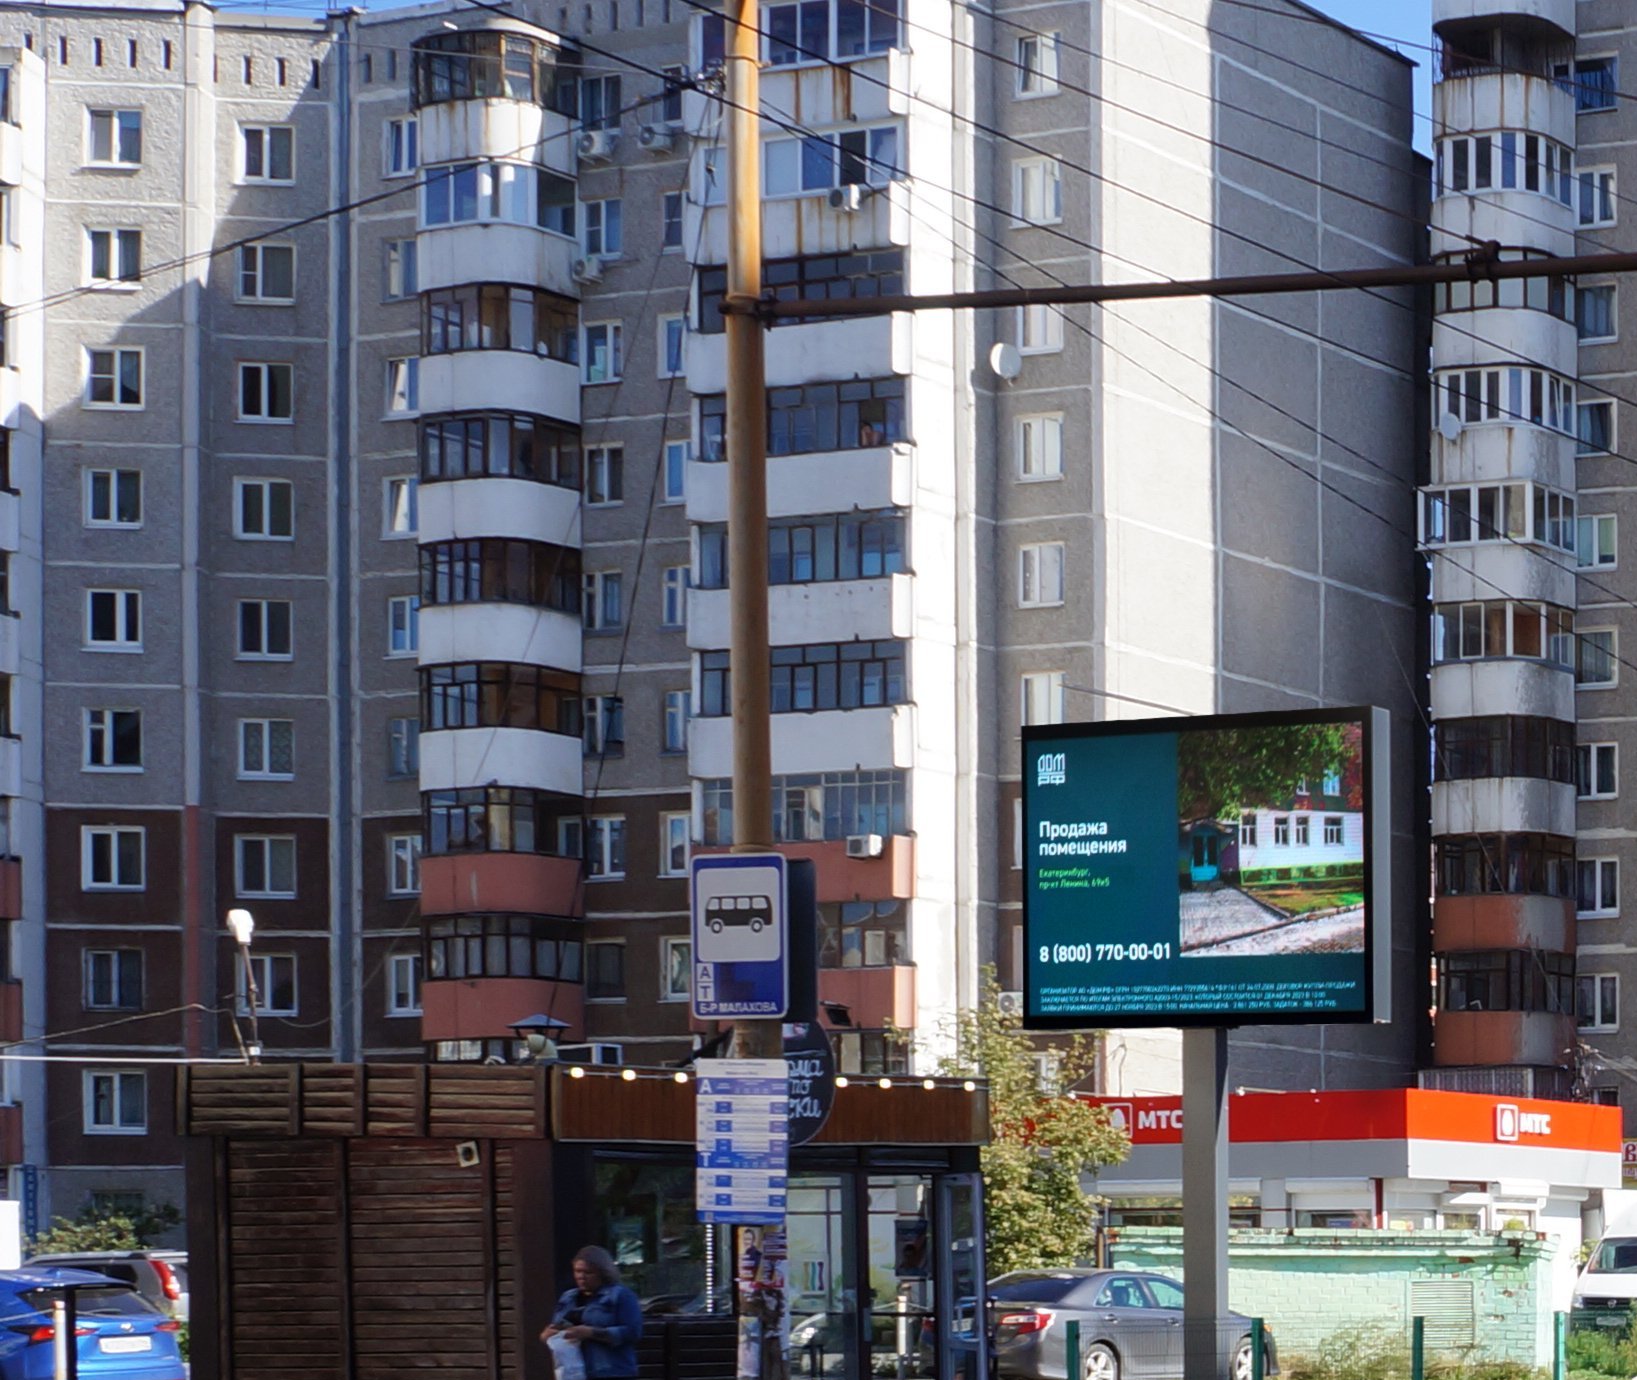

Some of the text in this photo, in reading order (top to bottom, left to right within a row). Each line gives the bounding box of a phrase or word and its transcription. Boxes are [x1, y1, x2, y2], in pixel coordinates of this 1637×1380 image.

[1037, 753, 1066, 773] ДОМ
[1039, 820, 1108, 840] Продажа
[1039, 839, 1127, 856] помещения
[1039, 942, 1171, 964] 8 (800) 770-00-01
[699, 967, 711, 980] А
[700, 985, 712, 999] Т
[719, 1002, 778, 1013] МАЛАХОВА
[699, 1079, 713, 1094] А
[1138, 1109, 1183, 1130] МТС
[1520, 1113, 1551, 1134] МТС
[700, 1153, 712, 1167] Т
